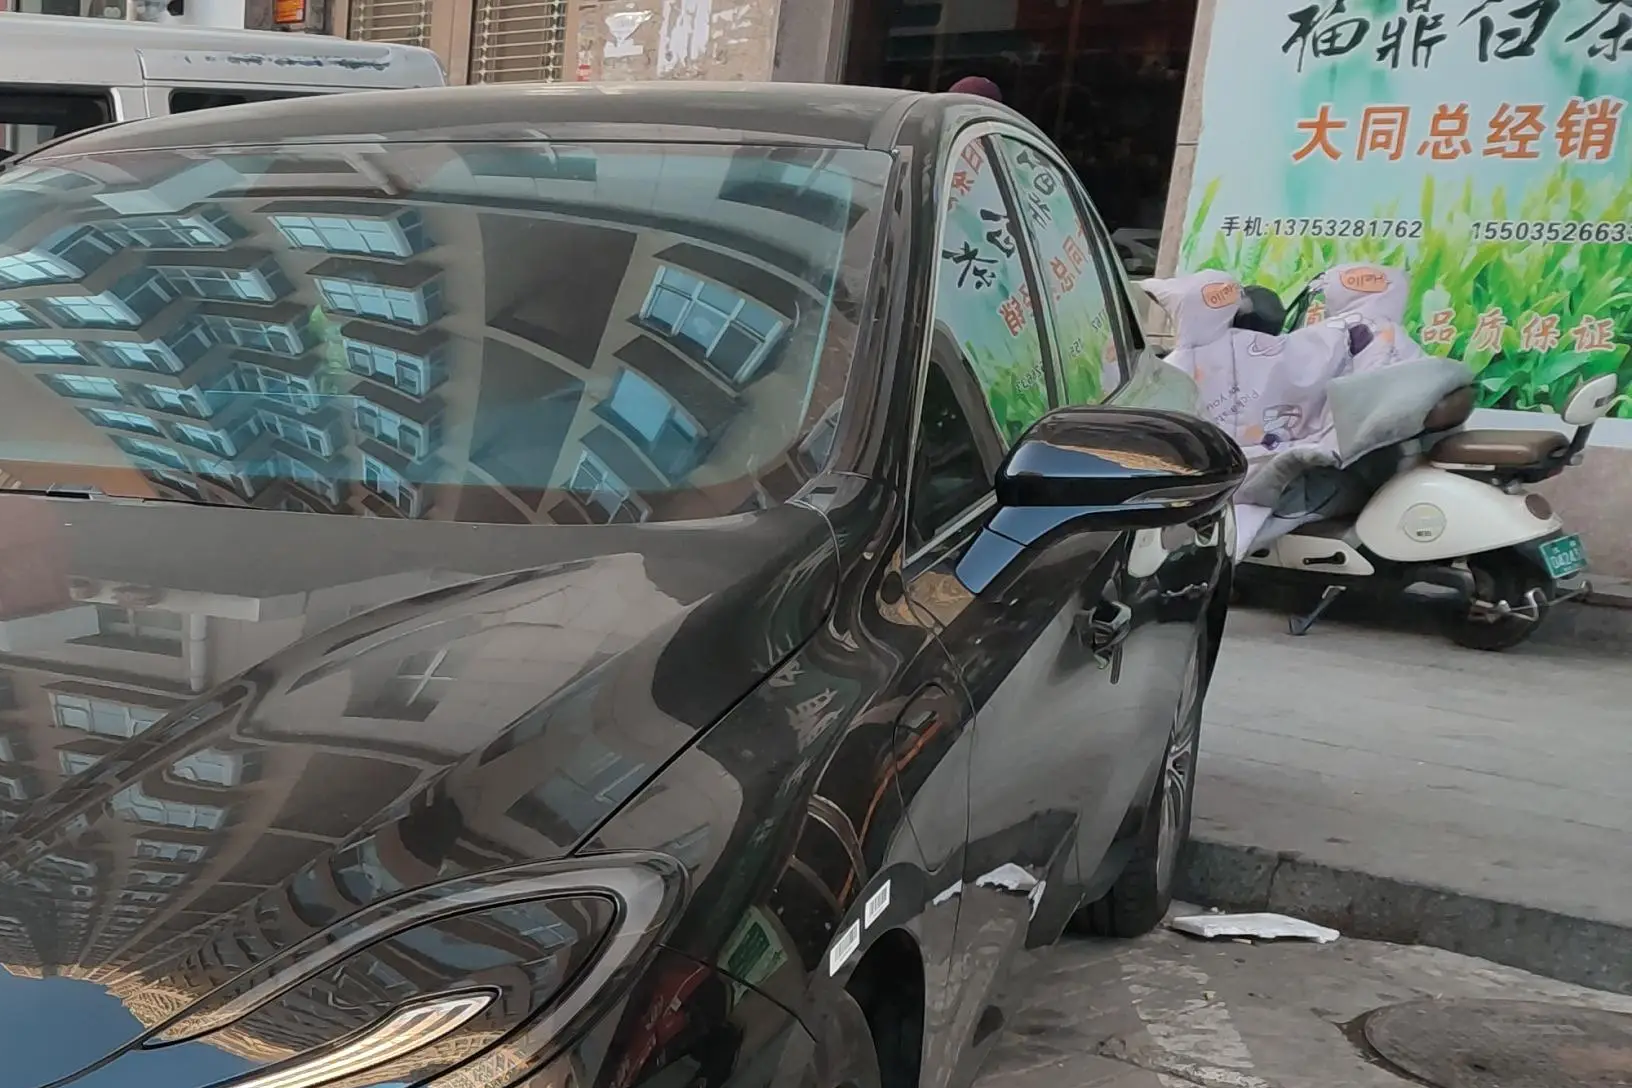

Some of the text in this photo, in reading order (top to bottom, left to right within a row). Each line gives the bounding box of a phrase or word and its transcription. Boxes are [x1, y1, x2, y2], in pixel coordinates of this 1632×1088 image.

[1291, 98, 1625, 162] 大同总经销
[1422, 308, 1617, 354] 品质保证
